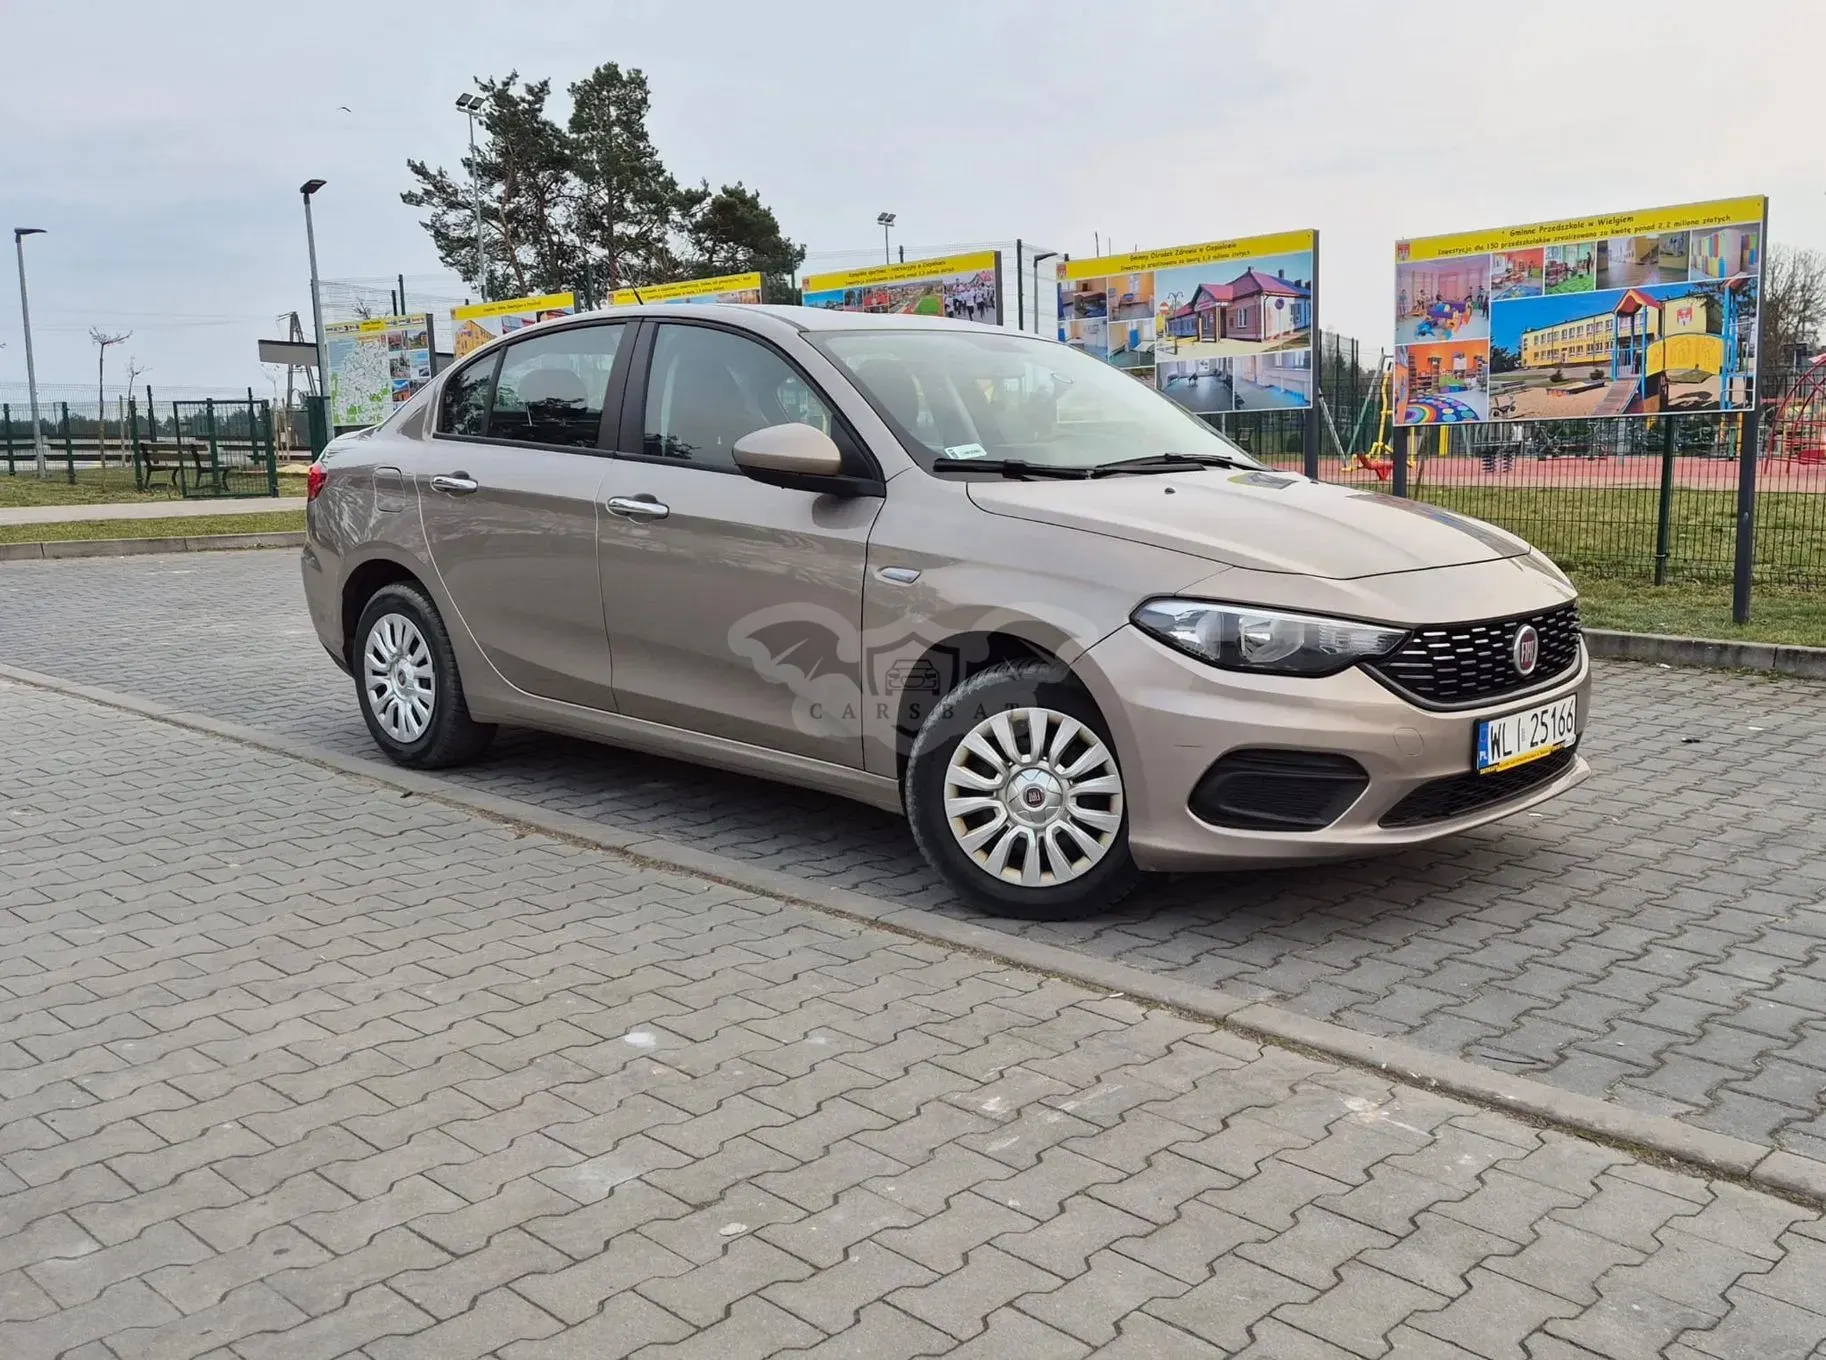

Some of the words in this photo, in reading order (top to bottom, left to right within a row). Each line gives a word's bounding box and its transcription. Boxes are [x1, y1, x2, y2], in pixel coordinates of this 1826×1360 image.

[1510, 228, 1536, 237] Gminne
[1539, 221, 1585, 233] Przedszkole
[1597, 215, 1634, 228] Wielgiem
[1487, 242, 1499, 250] 150
[1521, 641, 1535, 663] FIAT
[1491, 718, 1521, 761] WLI
[1530, 701, 1573, 746] 25166
